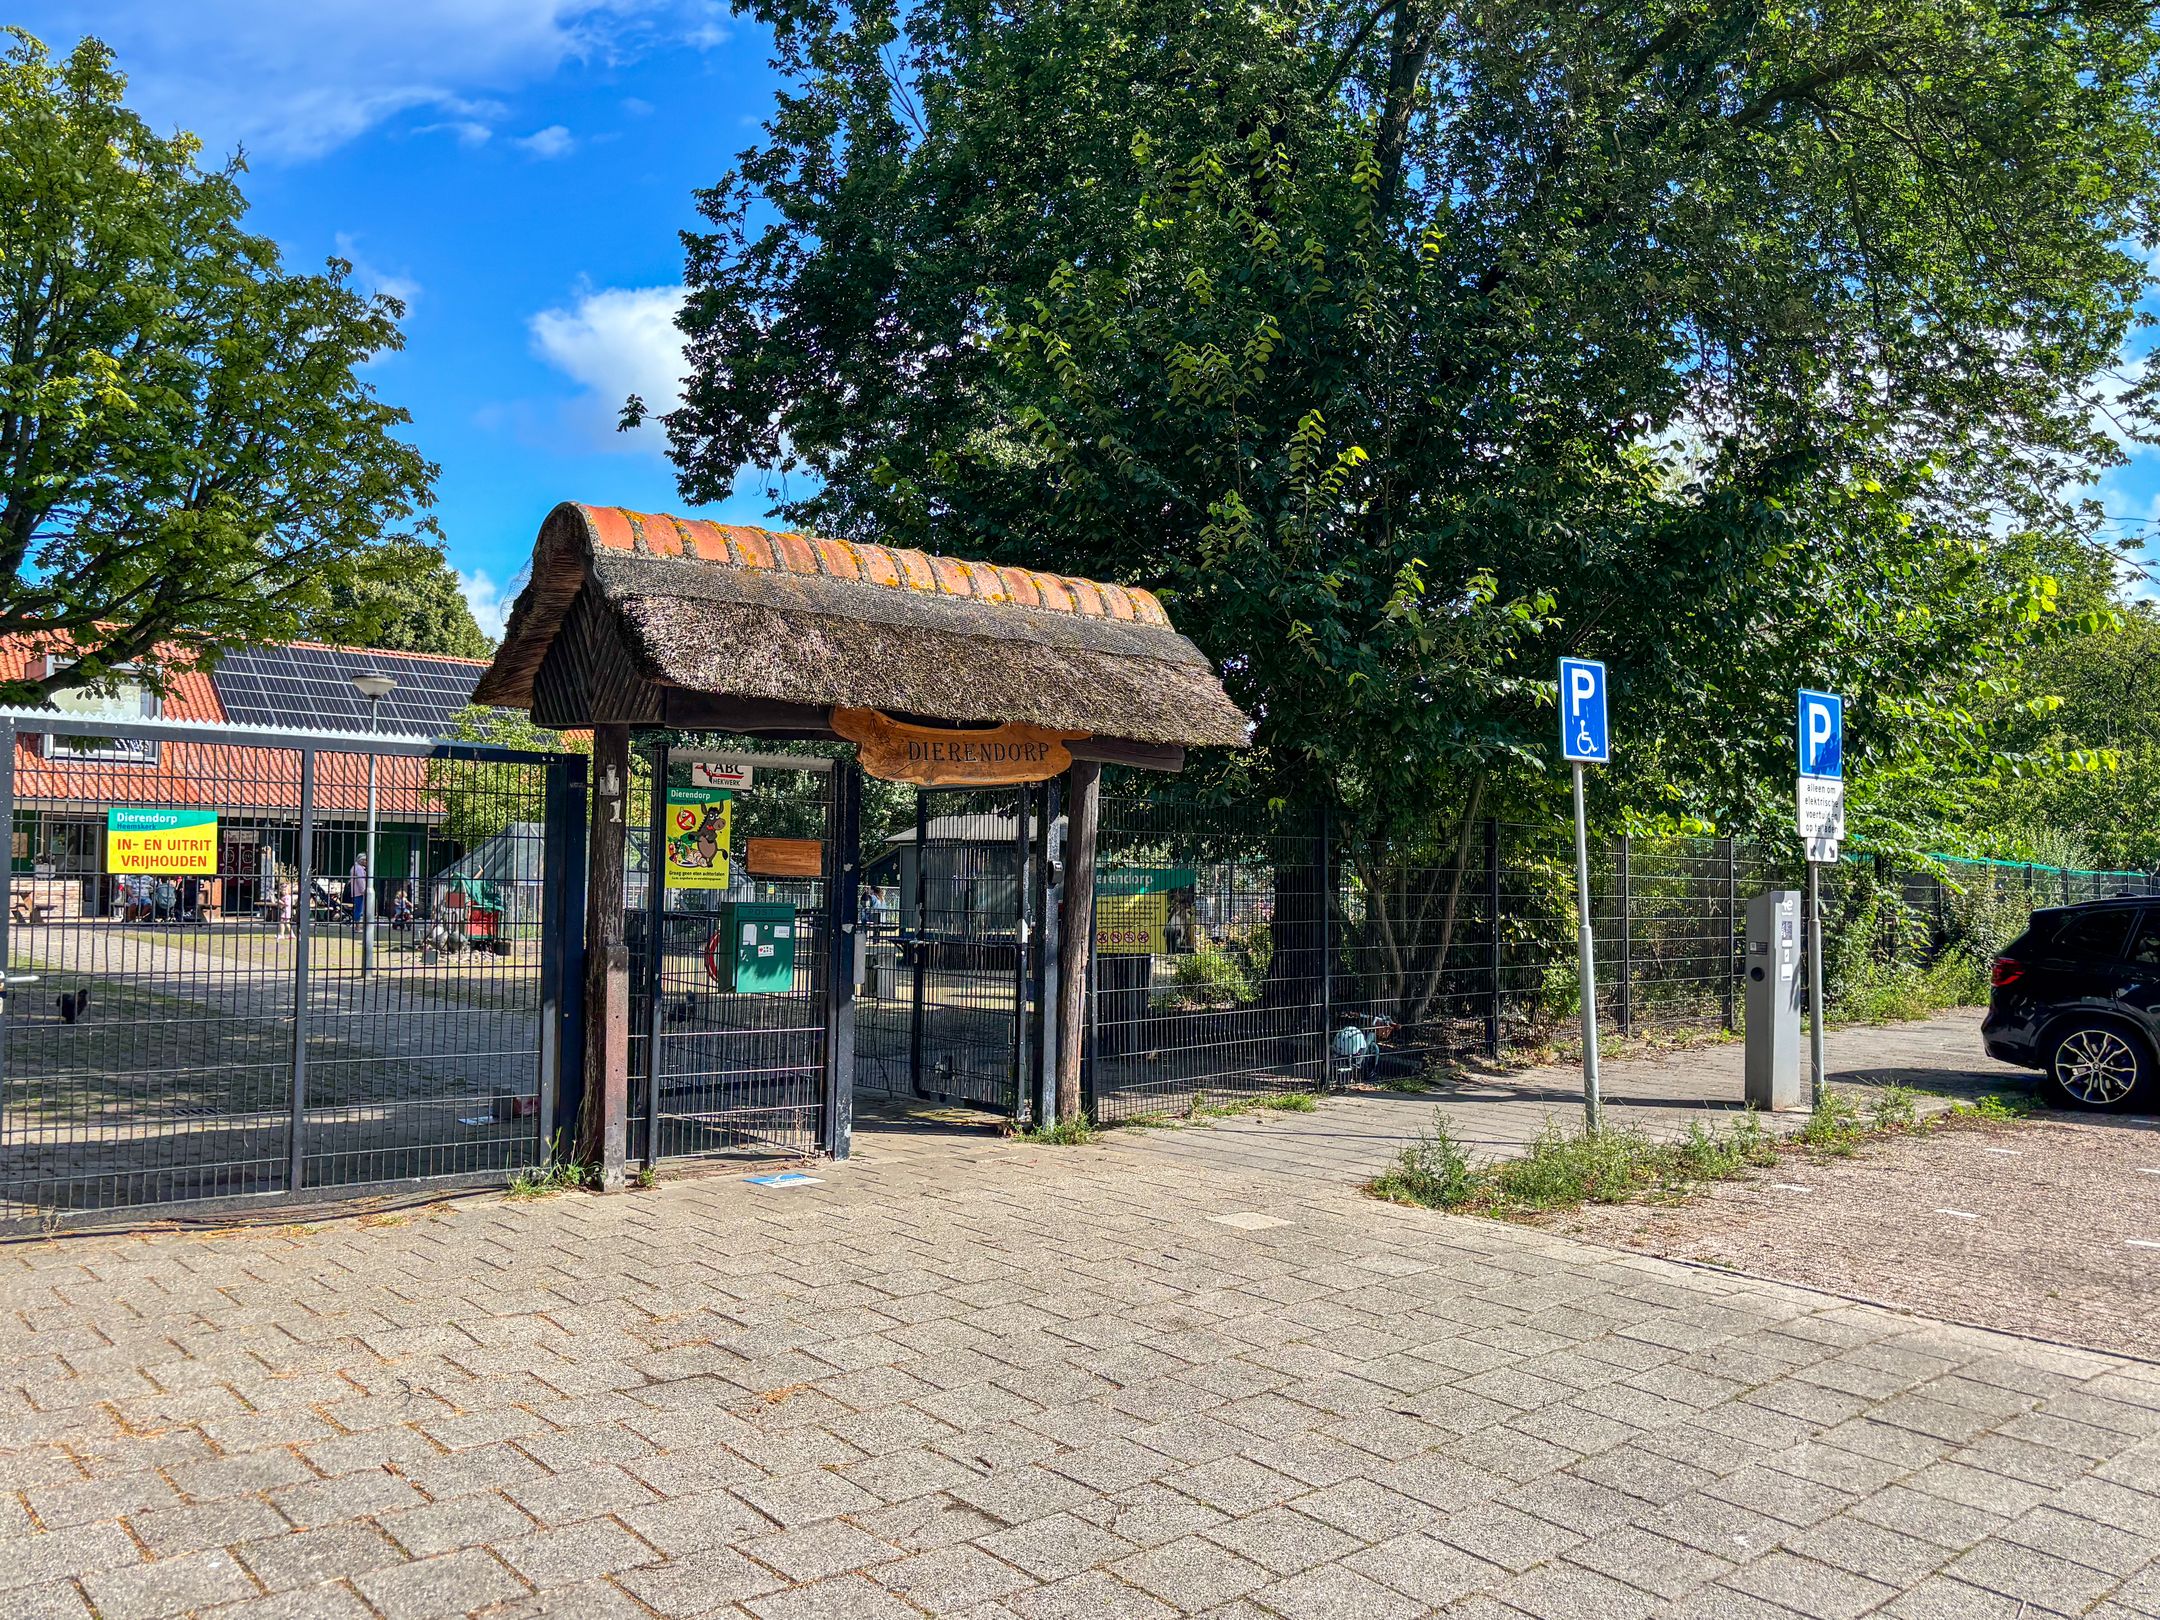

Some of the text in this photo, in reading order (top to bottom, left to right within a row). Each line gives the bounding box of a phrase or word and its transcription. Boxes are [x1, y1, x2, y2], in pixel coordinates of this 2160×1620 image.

[1571, 667, 1595, 717] P
[1808, 702, 1832, 767] P
[908, 741, 1049, 763] DIERENDORP
[714, 763, 744, 775] ABC
[712, 778, 741, 787] HEKWERK
[1806, 783, 1836, 794] alleen om
[671, 789, 711, 801] Dierendorp
[1804, 796, 1839, 808] elektrische
[610, 799, 622, 823] 1
[117, 812, 178, 826] Dierendorp
[117, 839, 212, 851] IN- EN UITRIT
[121, 855, 207, 869] VRIJHOUDEN
[1096, 871, 1153, 886] erendorp
[747, 908, 775, 916] POST
